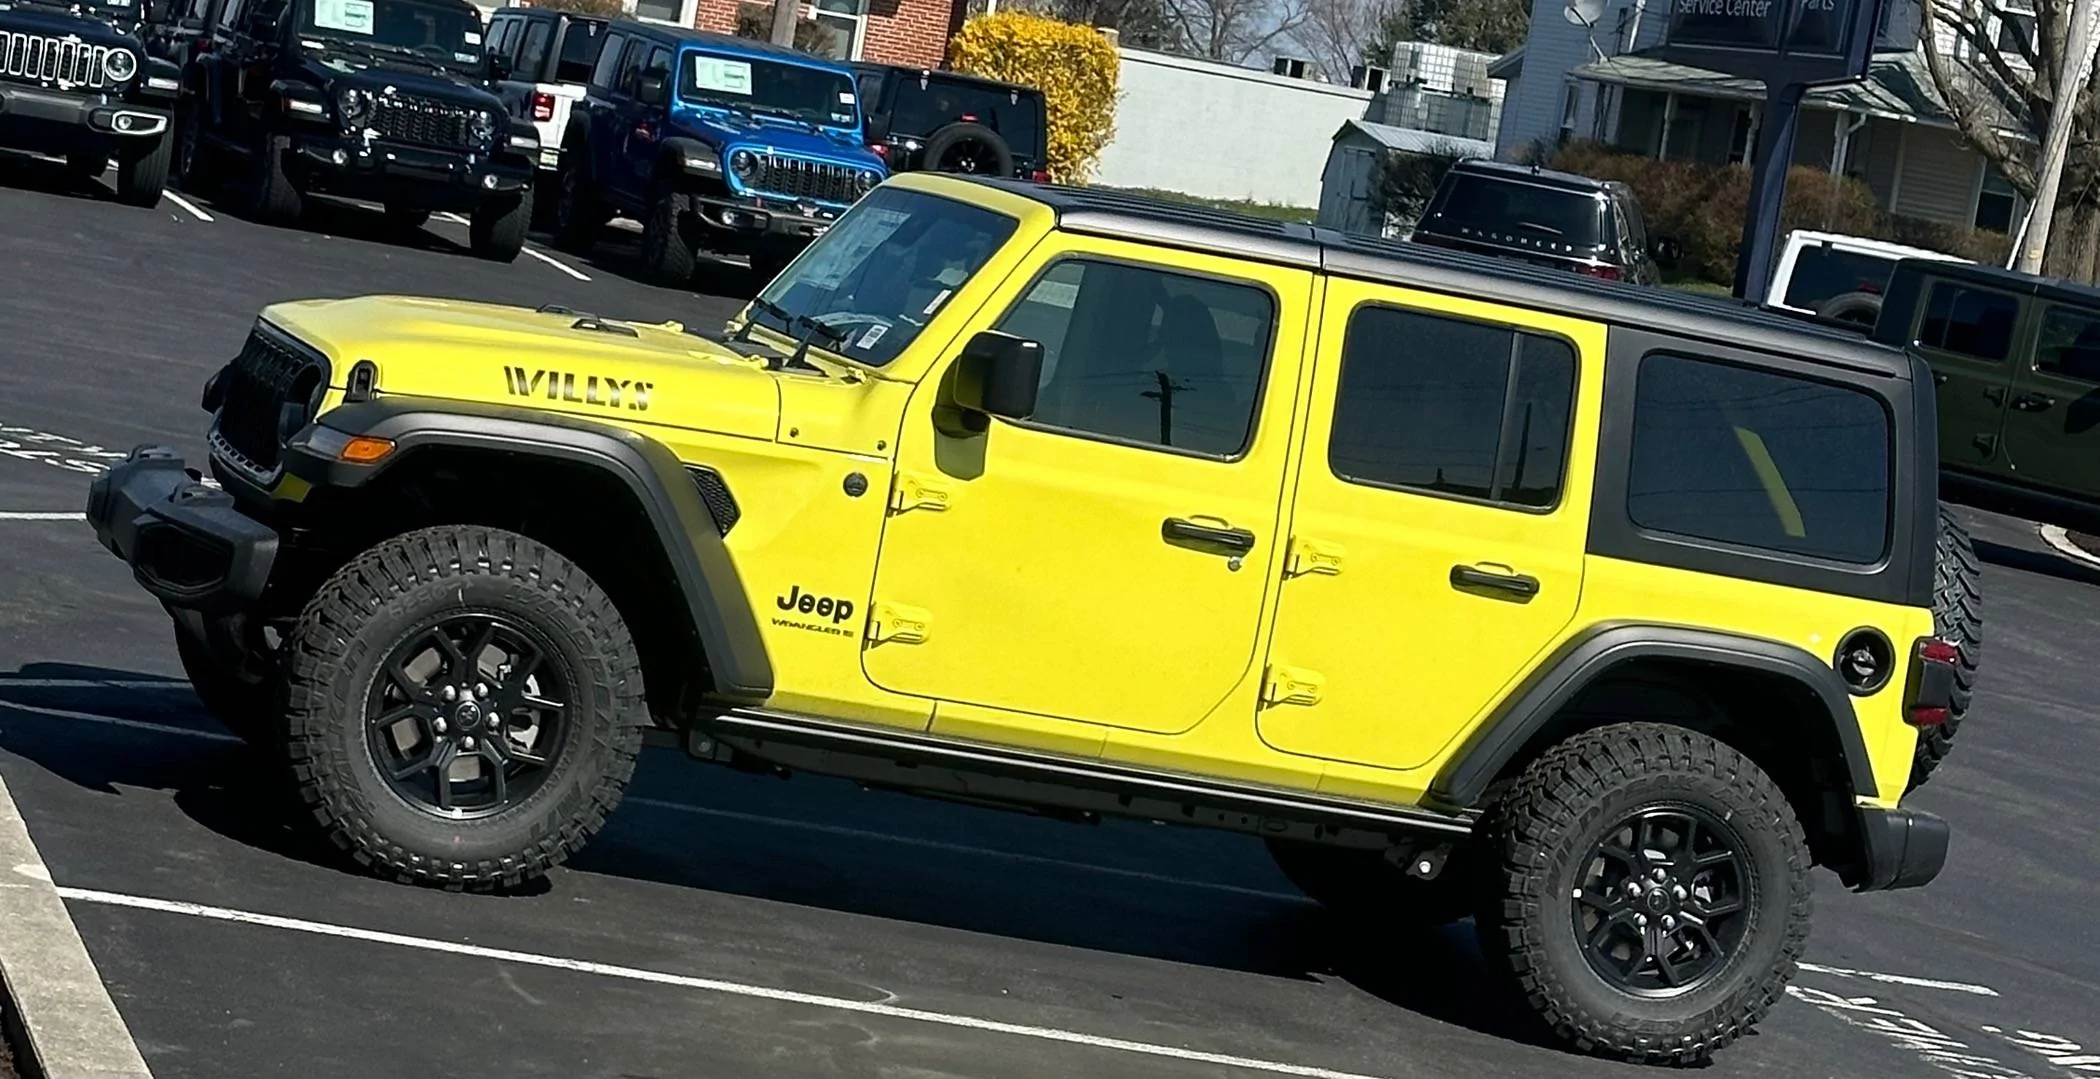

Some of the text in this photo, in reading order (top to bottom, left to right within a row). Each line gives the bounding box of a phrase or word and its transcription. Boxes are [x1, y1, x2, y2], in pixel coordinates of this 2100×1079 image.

[1679, 0, 1773, 17] Service Center
[503, 365, 654, 411] WILLYS
[776, 585, 854, 625] Jeep
